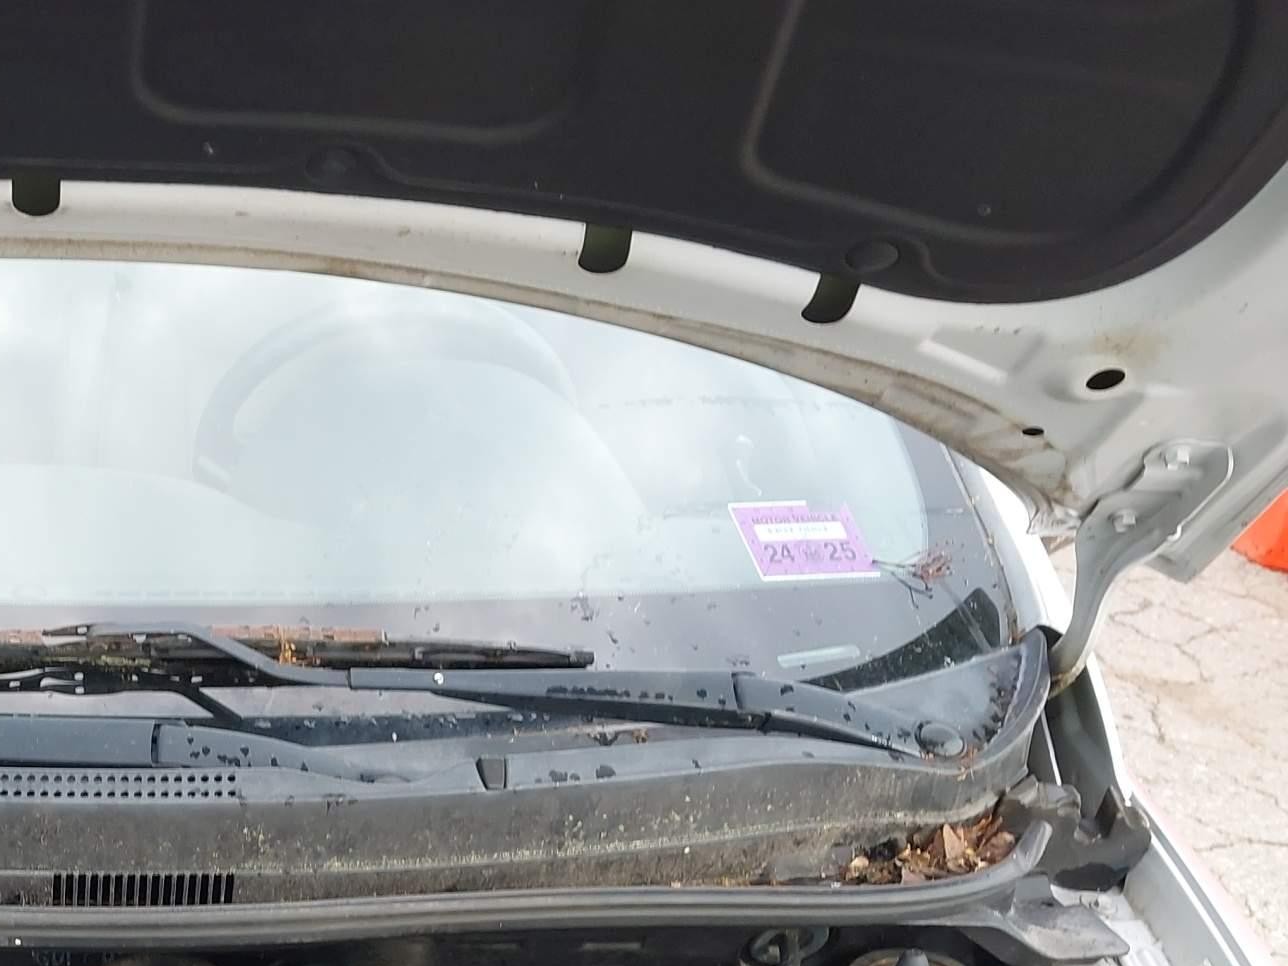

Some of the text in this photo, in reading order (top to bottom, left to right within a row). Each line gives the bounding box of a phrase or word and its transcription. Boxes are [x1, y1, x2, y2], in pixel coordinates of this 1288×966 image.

[752, 514, 791, 524] MOTOR
[763, 543, 795, 563] 24
[823, 541, 857, 561] 25
